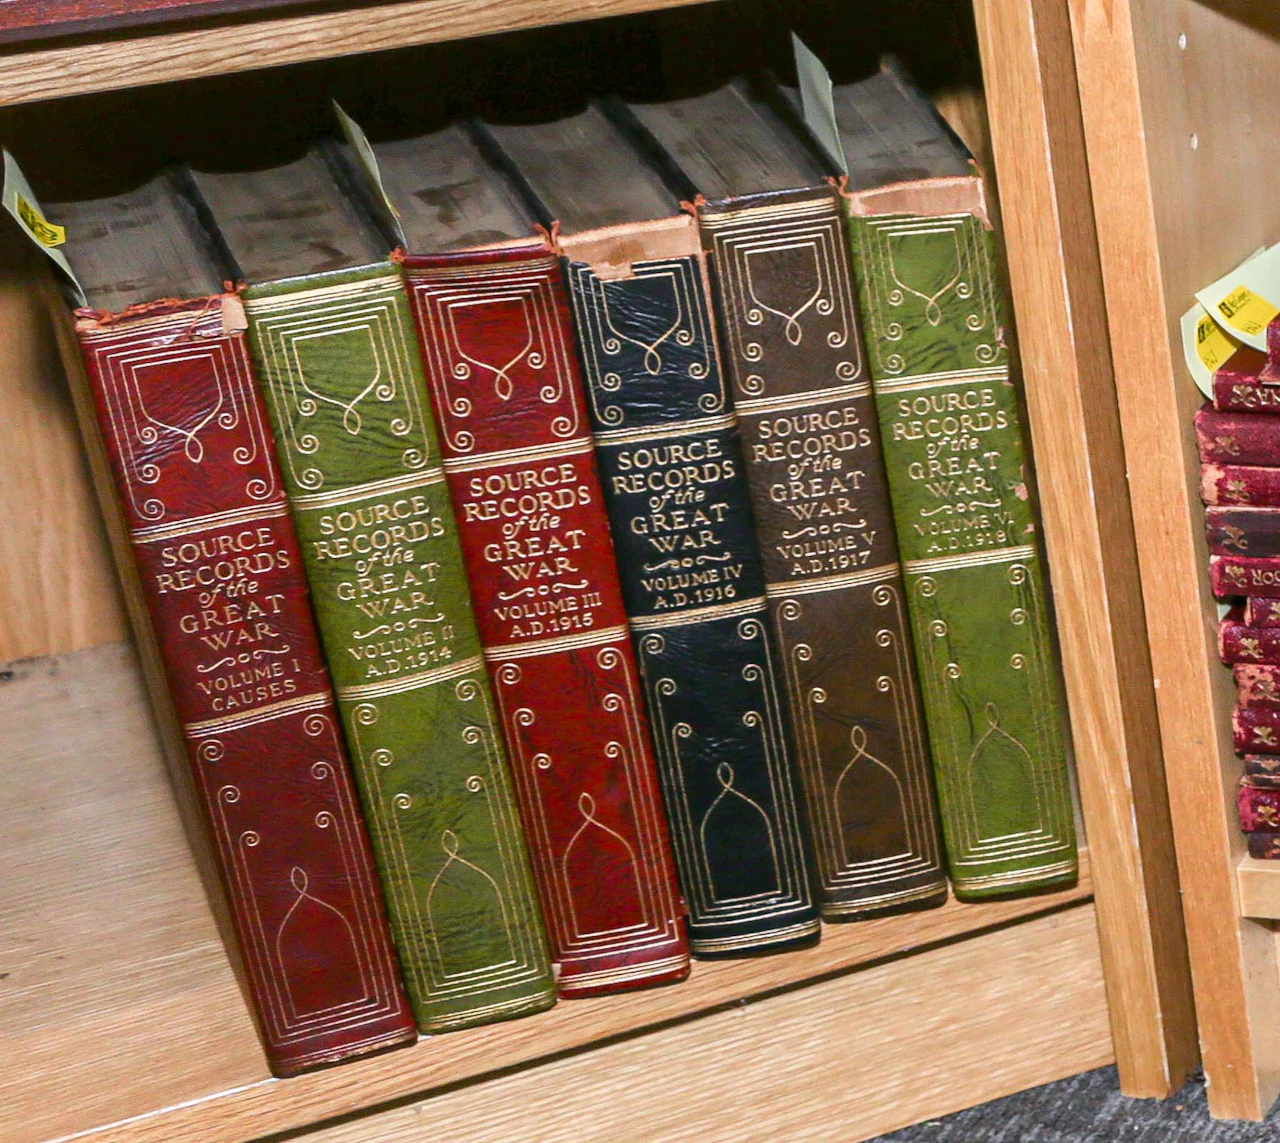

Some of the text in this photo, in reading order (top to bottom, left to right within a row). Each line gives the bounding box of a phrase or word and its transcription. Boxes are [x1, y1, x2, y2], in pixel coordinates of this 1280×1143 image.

[899, 389, 996, 416] SOURCE
[758, 407, 859, 440] SOURCE
[893, 410, 1008, 441] RECORDS
[617, 438, 723, 470] SOURCE
[752, 428, 871, 462] RECORDS
[926, 434, 979, 458] of the
[469, 464, 578, 498] SOURCE
[612, 460, 736, 495] RECORDS
[788, 453, 843, 480] of the
[908, 453, 1001, 480] GREAT
[649, 485, 706, 512] of the
[770, 471, 865, 502] GREAT
[926, 477, 993, 499] WAR
[320, 495, 430, 536] SOURCE
[464, 485, 592, 523] RECORDS
[630, 503, 729, 535] GREAT
[787, 497, 857, 522] WAR
[313, 517, 445, 561] RECORDS
[502, 512, 560, 540] of the
[914, 513, 993, 536] VOLUME
[161, 527, 275, 568] SOURCE
[484, 529, 587, 563] GREAT
[648, 529, 721, 554] WAR
[776, 531, 876, 560] VOLUME V
[157, 551, 291, 594] RECORDS
[355, 547, 415, 574] of the
[503, 555, 579, 582] WAR
[198, 578, 259, 608] of the
[336, 562, 441, 601] GREAT
[641, 563, 742, 593] VOLUME IV
[180, 594, 284, 635] GREAT
[355, 590, 434, 620] WAR
[494, 591, 602, 623] VOLUME III
[202, 622, 279, 652] WAR
[348, 626, 456, 662] VOLUME II
[198, 658, 300, 695] VOLUME I
[211, 679, 297, 712] CAUSES
